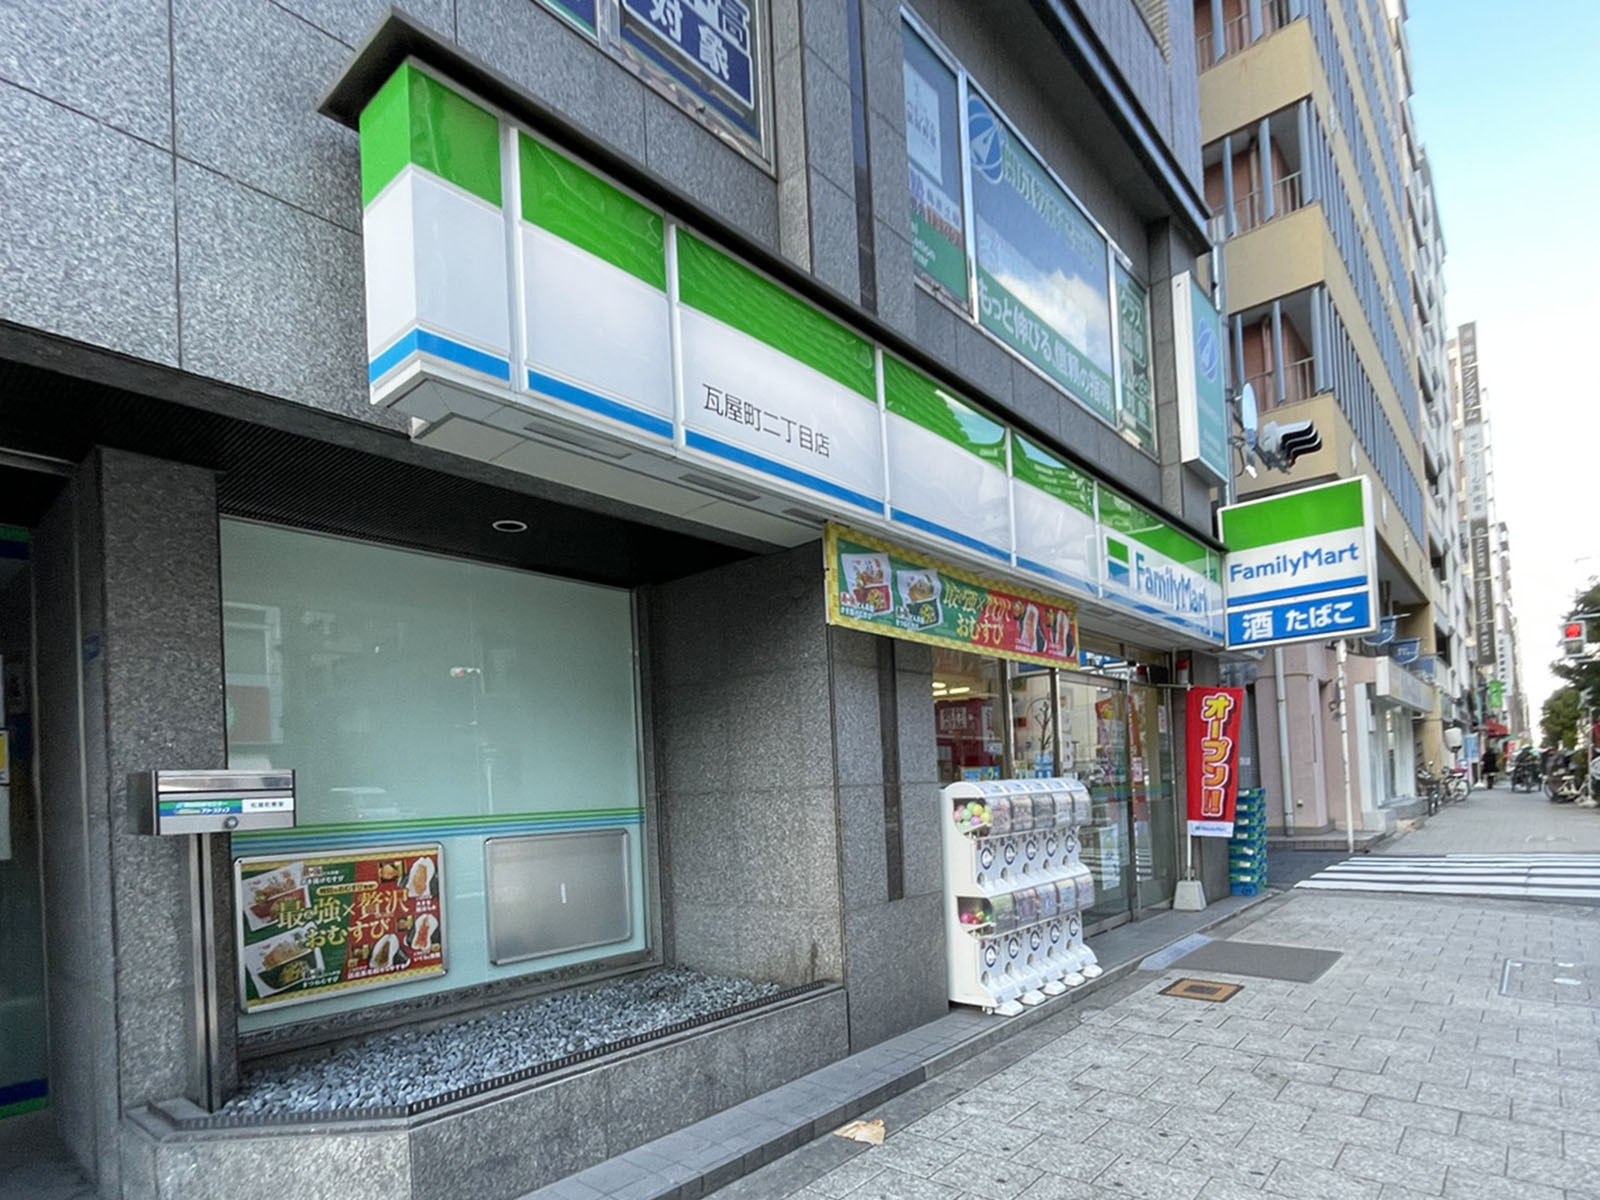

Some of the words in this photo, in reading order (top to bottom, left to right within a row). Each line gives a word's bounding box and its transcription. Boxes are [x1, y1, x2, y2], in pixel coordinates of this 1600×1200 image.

[702, 383, 830, 458] 瓦屋町二丁目店
[1230, 542, 1359, 582] FamilyMart
[1135, 551, 1208, 615] FamilyMart
[957, 613, 1004, 645] おむすび
[1242, 611, 1273, 641] 酒
[1285, 601, 1355, 632] たばこ
[305, 918, 391, 949] おむすび
